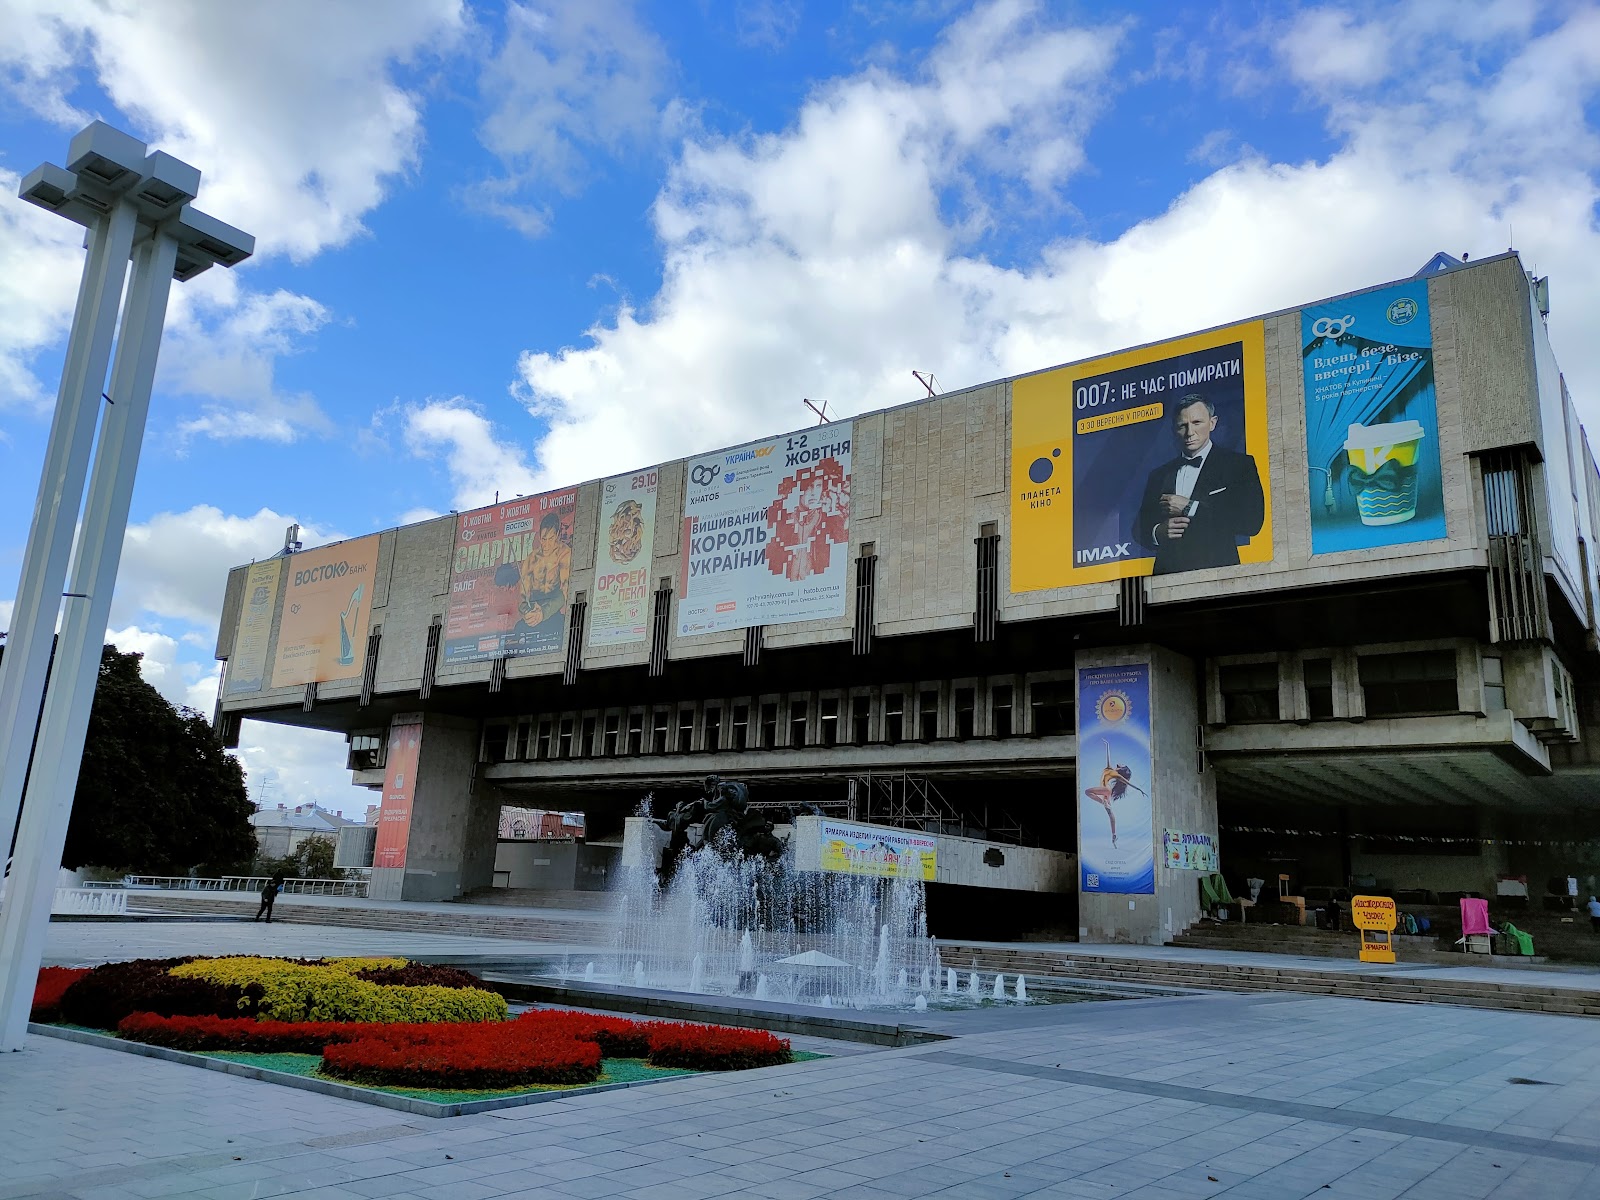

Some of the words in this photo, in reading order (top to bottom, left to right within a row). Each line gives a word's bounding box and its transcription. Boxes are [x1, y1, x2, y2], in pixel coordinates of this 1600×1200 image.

[1314, 352, 1358, 368] Вдень
[1362, 344, 1398, 358] безе,
[1314, 360, 1370, 381] ввечері
[1386, 352, 1422, 366] Бізе.
[1076, 381, 1116, 410] 007:
[1122, 382, 1136, 400] НЕ
[1140, 376, 1165, 394] ЧАС
[1169, 358, 1240, 390] ПОМИРАТИ
[1315, 382, 1342, 394] ХНАТОБ
[1322, 391, 1340, 401] років
[1340, 384, 1384, 396] партнерства.
[1086, 421, 1094, 430] 30
[1096, 414, 1124, 428] ВЕРЕСНЯ
[786, 434, 808, 451] 1-2
[784, 440, 850, 468] ЖОВТНЯ
[631, 472, 657, 490] 29.10
[738, 484, 750, 493] nix
[540, 496, 548, 510] 10
[548, 492, 576, 508] ЖОВТНЯ
[690, 492, 720, 505] ХНАТОБ
[1020, 486, 1061, 501] ПЛАНЕТА
[500, 506, 505, 520] 9
[506, 504, 530, 518] ЖОВТНЯ
[1030, 498, 1052, 509] КІНО
[463, 516, 468, 528] 8
[468, 513, 492, 527] ЖОВТНЯ
[506, 520, 528, 531] ВОСТОК
[692, 506, 768, 534] ВИШИВАНИЙ
[690, 526, 767, 556] КОРОЛЬ
[454, 532, 536, 574] СПАРТАК
[1076, 542, 1131, 564] IMAX
[690, 548, 766, 578] УКРАЇНИ
[294, 562, 341, 587] ВОСТОК
[350, 563, 368, 575] БАНК
[598, 566, 647, 592] ОРФЕЙ
[454, 580, 477, 593] БАЛЕТ
[618, 585, 646, 602] ПЕКЛІ
[824, 827, 849, 838] ЯРМАРКА
[849, 830, 872, 840] ИЗДЕЛИЙ
[872, 834, 892, 843] РУЧНОЙ
